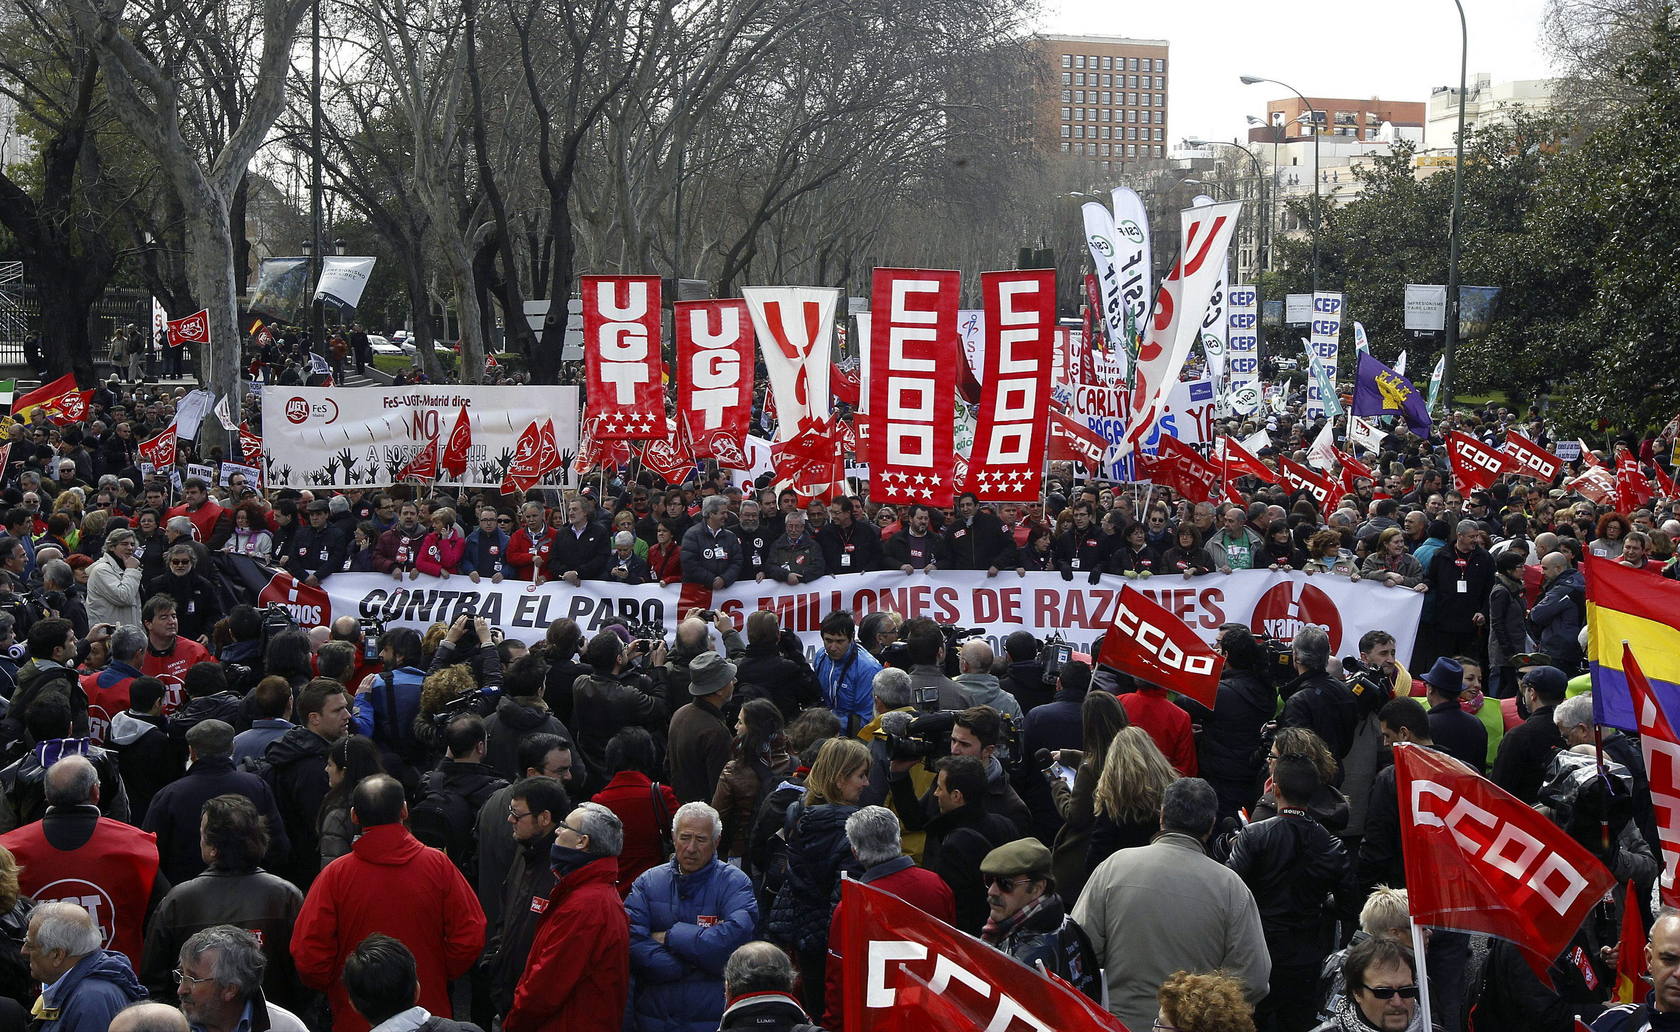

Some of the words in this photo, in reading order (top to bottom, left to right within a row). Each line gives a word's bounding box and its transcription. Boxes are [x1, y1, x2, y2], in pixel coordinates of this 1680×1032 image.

[1230, 292, 1256, 306] CEP
[1314, 297, 1341, 313] CEP
[1230, 314, 1256, 328] CEP
[1312, 320, 1339, 335] CEP
[597, 281, 649, 405] UGT
[1230, 336, 1257, 350] CEP
[690, 307, 740, 430] UGT
[887, 279, 940, 468] CCOO
[986, 279, 1040, 465] CCOO
[1231, 358, 1257, 372] CEP
[288, 400, 307, 412] UGT
[312, 404, 328, 413] FeS
[383, 394, 450, 408] FeS-UGT-Madrid
[451, 395, 471, 407] dice
[412, 409, 439, 441] NO
[366, 445, 379, 462] A
[383, 445, 409, 464] LOS
[1504, 441, 1555, 478] CCOO
[358, 588, 503, 626] CONTRA
[511, 594, 553, 629] EL
[568, 596, 665, 632] PARO
[720, 599, 744, 632] 6
[757, 586, 960, 632] MILLONES
[973, 588, 1023, 624] DE
[1114, 602, 1214, 675] CCOO
[88, 716, 109, 739] GT
[1283, 808, 1305, 817] Canon
[1411, 780, 1589, 916] CCOO
